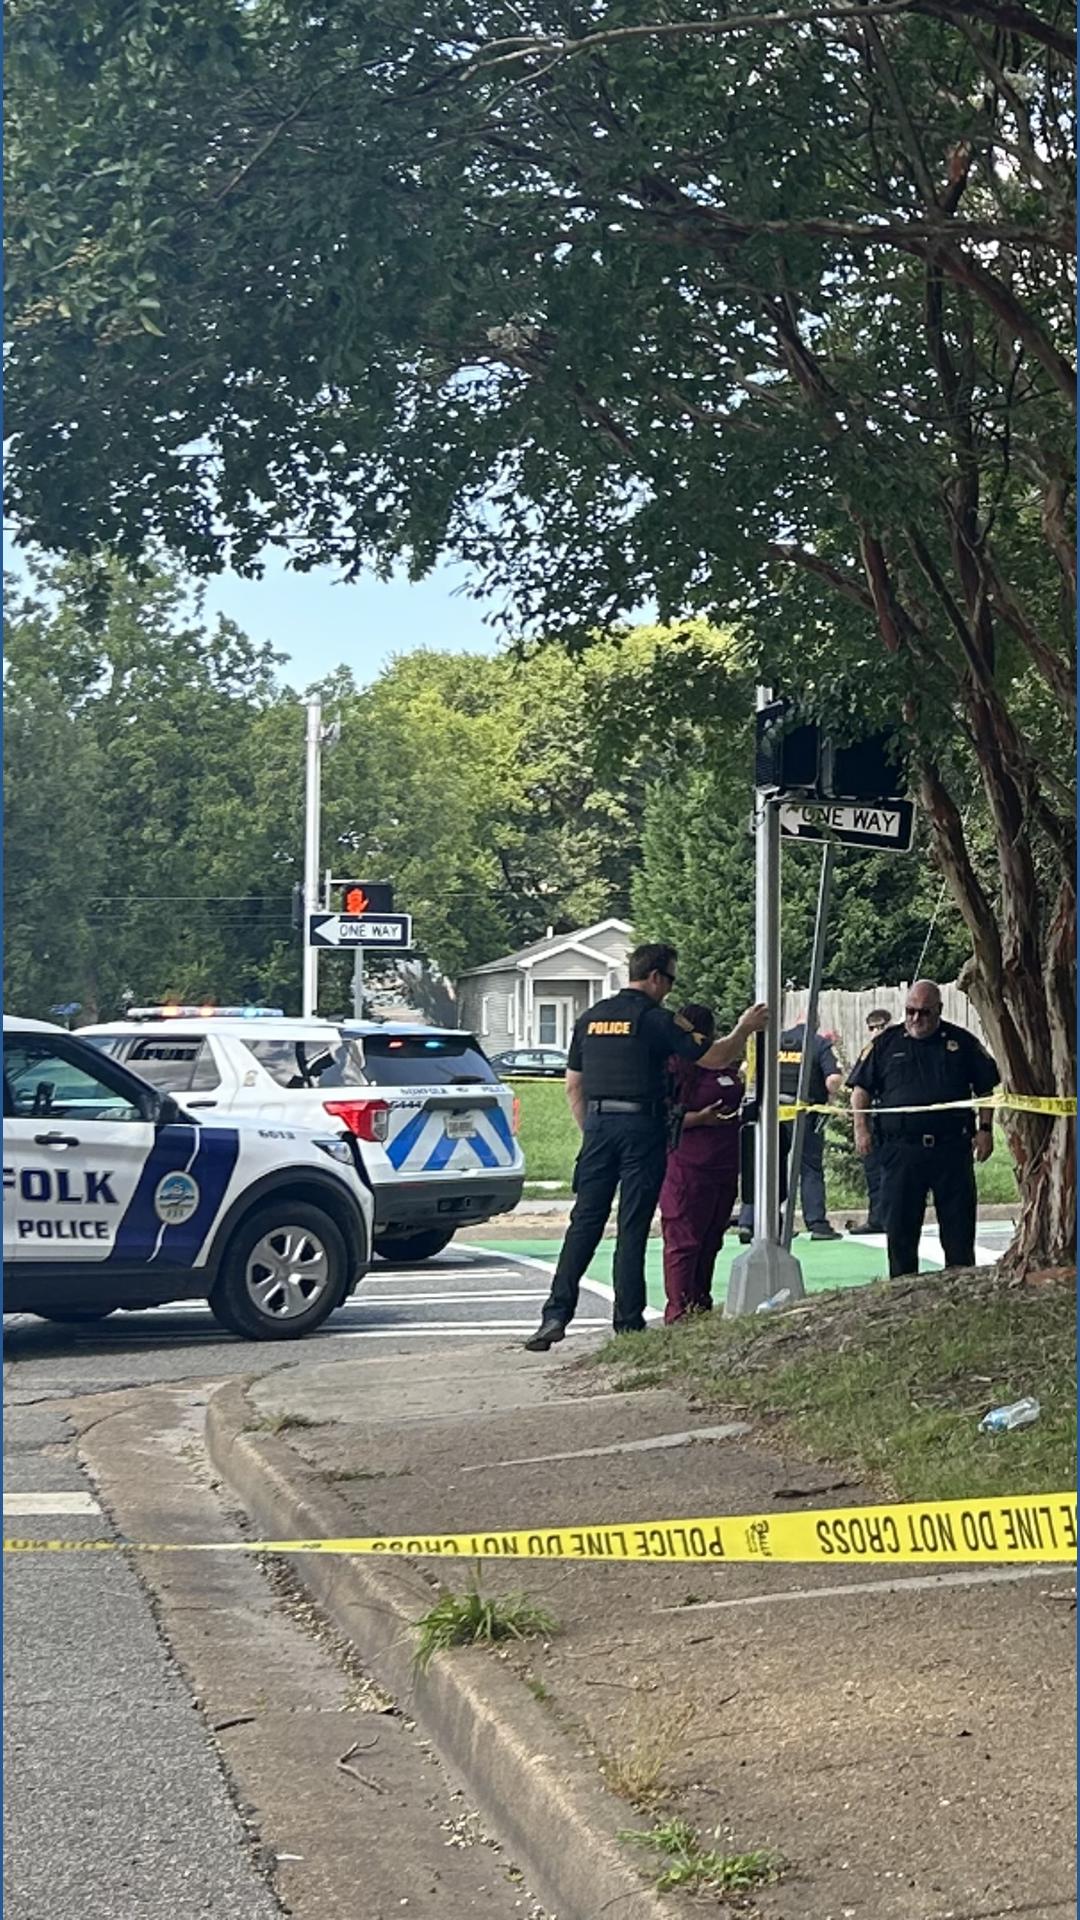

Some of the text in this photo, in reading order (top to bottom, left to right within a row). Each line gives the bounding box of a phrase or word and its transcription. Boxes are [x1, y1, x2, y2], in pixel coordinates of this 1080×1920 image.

[802, 806, 896, 833] ONE WAY
[339, 924, 399, 937] ONE WAY
[587, 1021, 631, 1035] POLICE
[17, 1219, 110, 1239] POLICE
[634, 1526, 725, 1557] POLICE
[815, 1516, 900, 1554] CROSS
[907, 1512, 957, 1552] NOT
[960, 1510, 998, 1551] DO
[1000, 1507, 1059, 1549] LINE
[528, 1534, 564, 1556] DO
[570, 1531, 628, 1556] LINE
